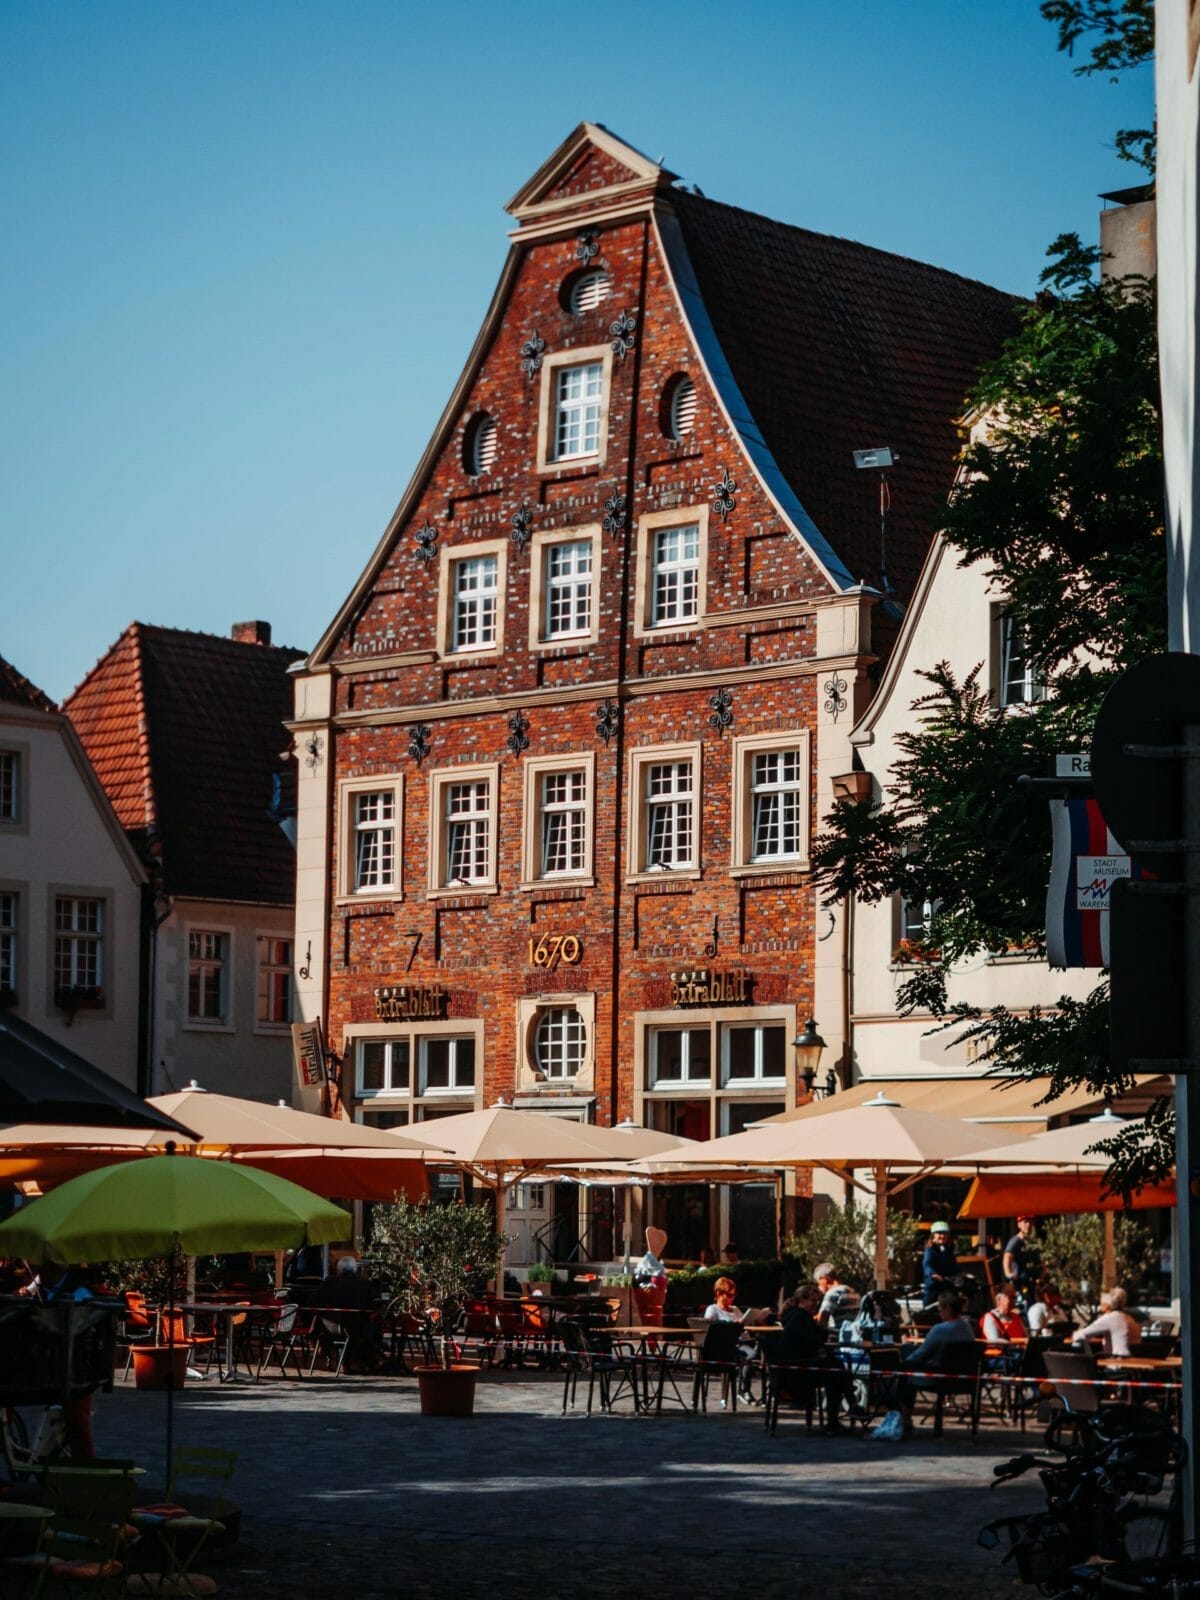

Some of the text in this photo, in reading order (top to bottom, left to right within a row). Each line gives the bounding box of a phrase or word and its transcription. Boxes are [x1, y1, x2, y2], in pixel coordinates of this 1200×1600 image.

[1071, 757, 1091, 772] Ra
[1093, 868, 1130, 876] MUSEUM
[1079, 900, 1110, 908] WAREN
[528, 931, 579, 969] 1670
[670, 971, 706, 981] CAFE
[374, 988, 406, 998] CAFE
[671, 967, 748, 1004] extrablatt
[375, 985, 444, 1018] extrablatt
[300, 1031, 319, 1085] extrablatt
